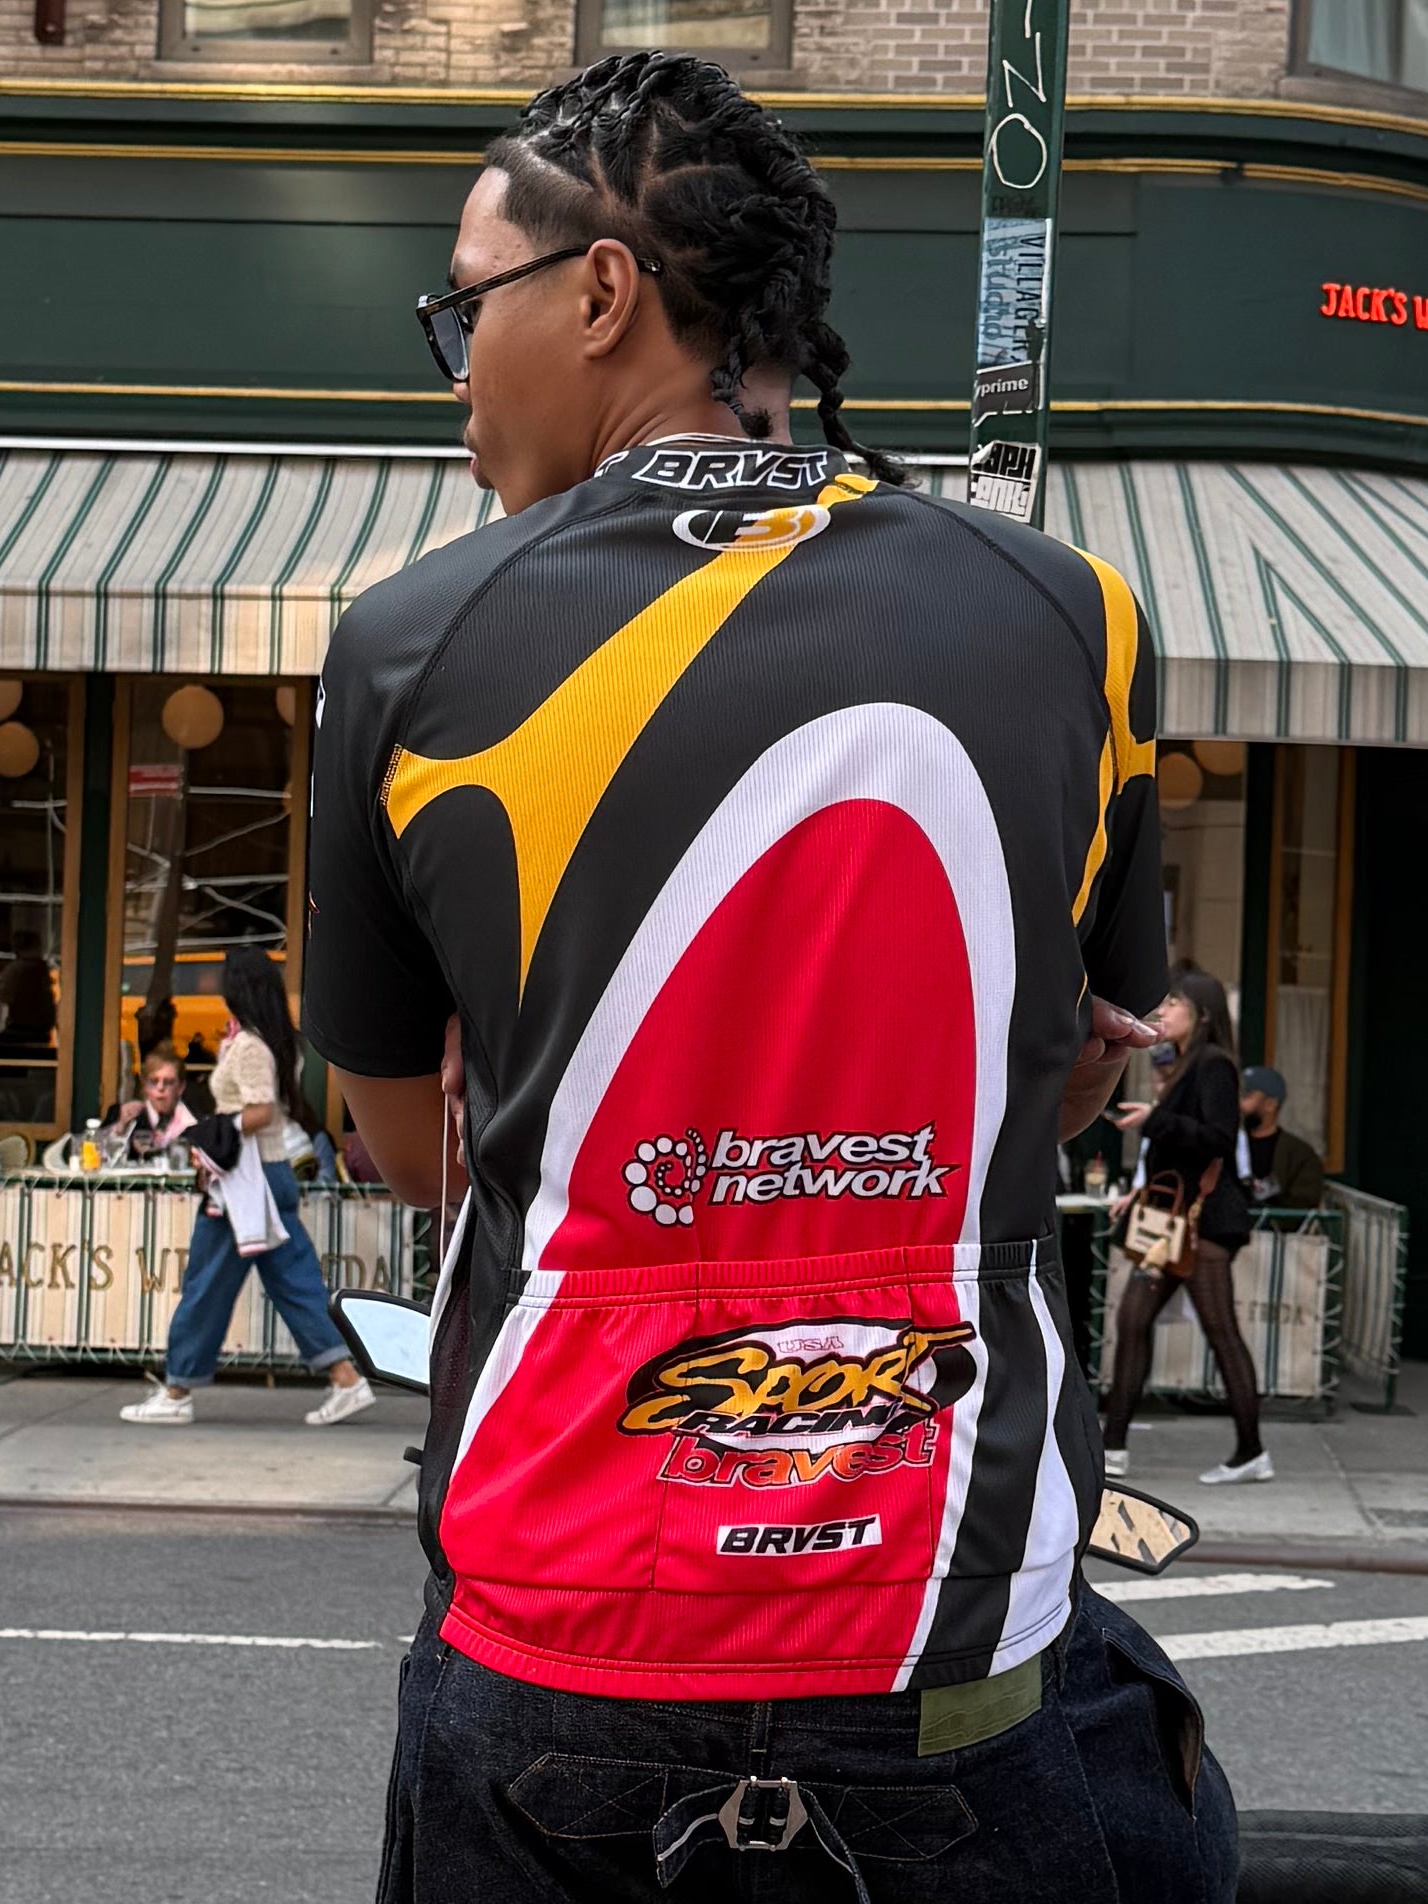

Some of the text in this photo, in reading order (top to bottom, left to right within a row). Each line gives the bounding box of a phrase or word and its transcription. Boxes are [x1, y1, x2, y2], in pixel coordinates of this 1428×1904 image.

[1320, 282, 1408, 325] JACK'S
[631, 449, 828, 490] BRVST
[711, 1121, 936, 1169] bravest
[711, 1158, 956, 1203] network
[776, 1335, 845, 1354] USA
[657, 1418, 941, 1490] bravest
[720, 1516, 877, 1554] BRVST
